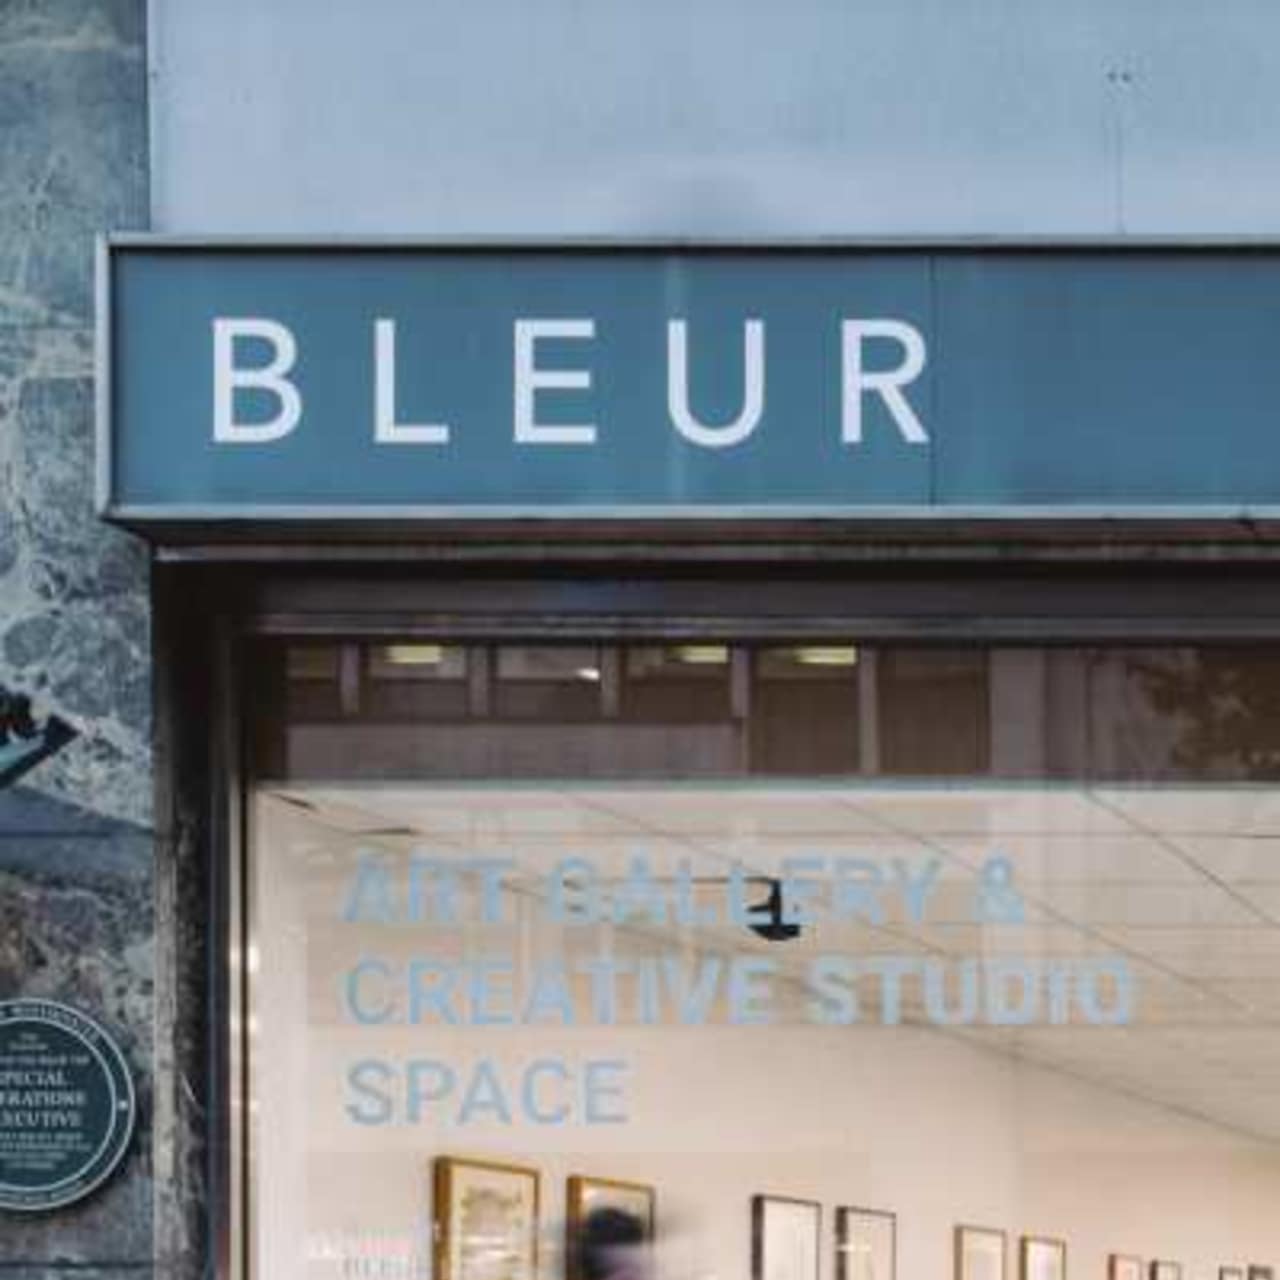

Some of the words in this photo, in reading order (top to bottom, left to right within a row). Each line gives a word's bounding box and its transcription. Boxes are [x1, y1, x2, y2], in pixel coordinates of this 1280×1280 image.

[212, 317, 930, 447] BLEUR
[343, 856, 513, 924] ART
[549, 854, 942, 924] GALLERY
[971, 854, 1026, 924] &
[344, 958, 783, 1026] CREATIVE
[807, 957, 1135, 1026] STUDIO
[344, 1058, 630, 1126] SPACE
